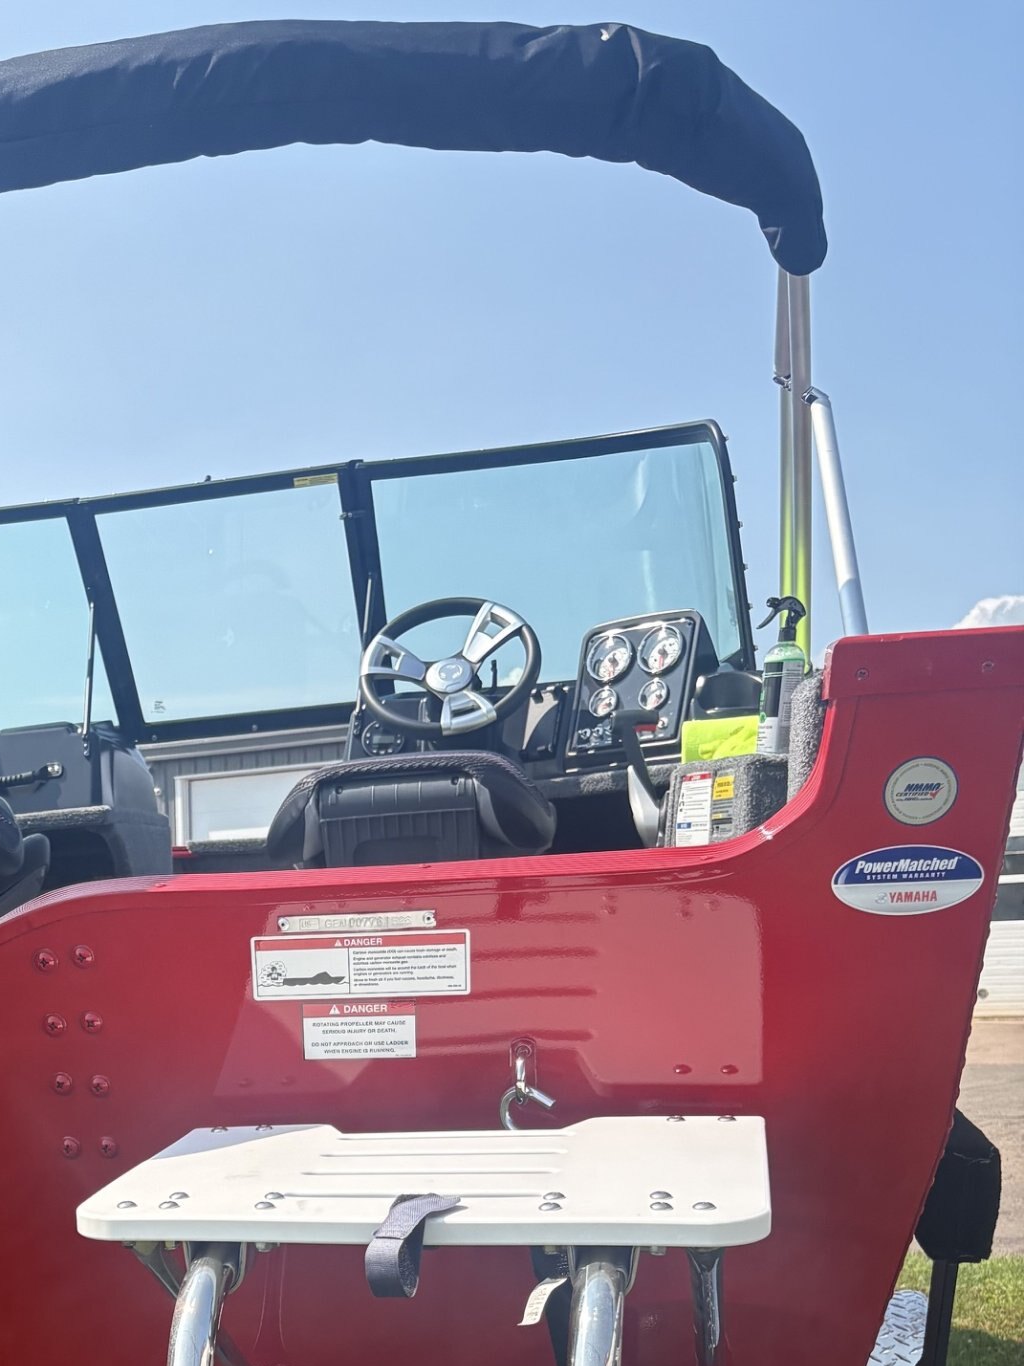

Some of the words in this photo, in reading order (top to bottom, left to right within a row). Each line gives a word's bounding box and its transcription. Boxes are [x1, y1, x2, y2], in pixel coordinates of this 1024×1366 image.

[855, 856, 959, 874] PowerMatched
[902, 871, 946, 879] WARRANTY
[889, 890, 938, 904] YAMAHA
[343, 937, 383, 947] DANGER
[343, 1004, 388, 1014] DANGER
